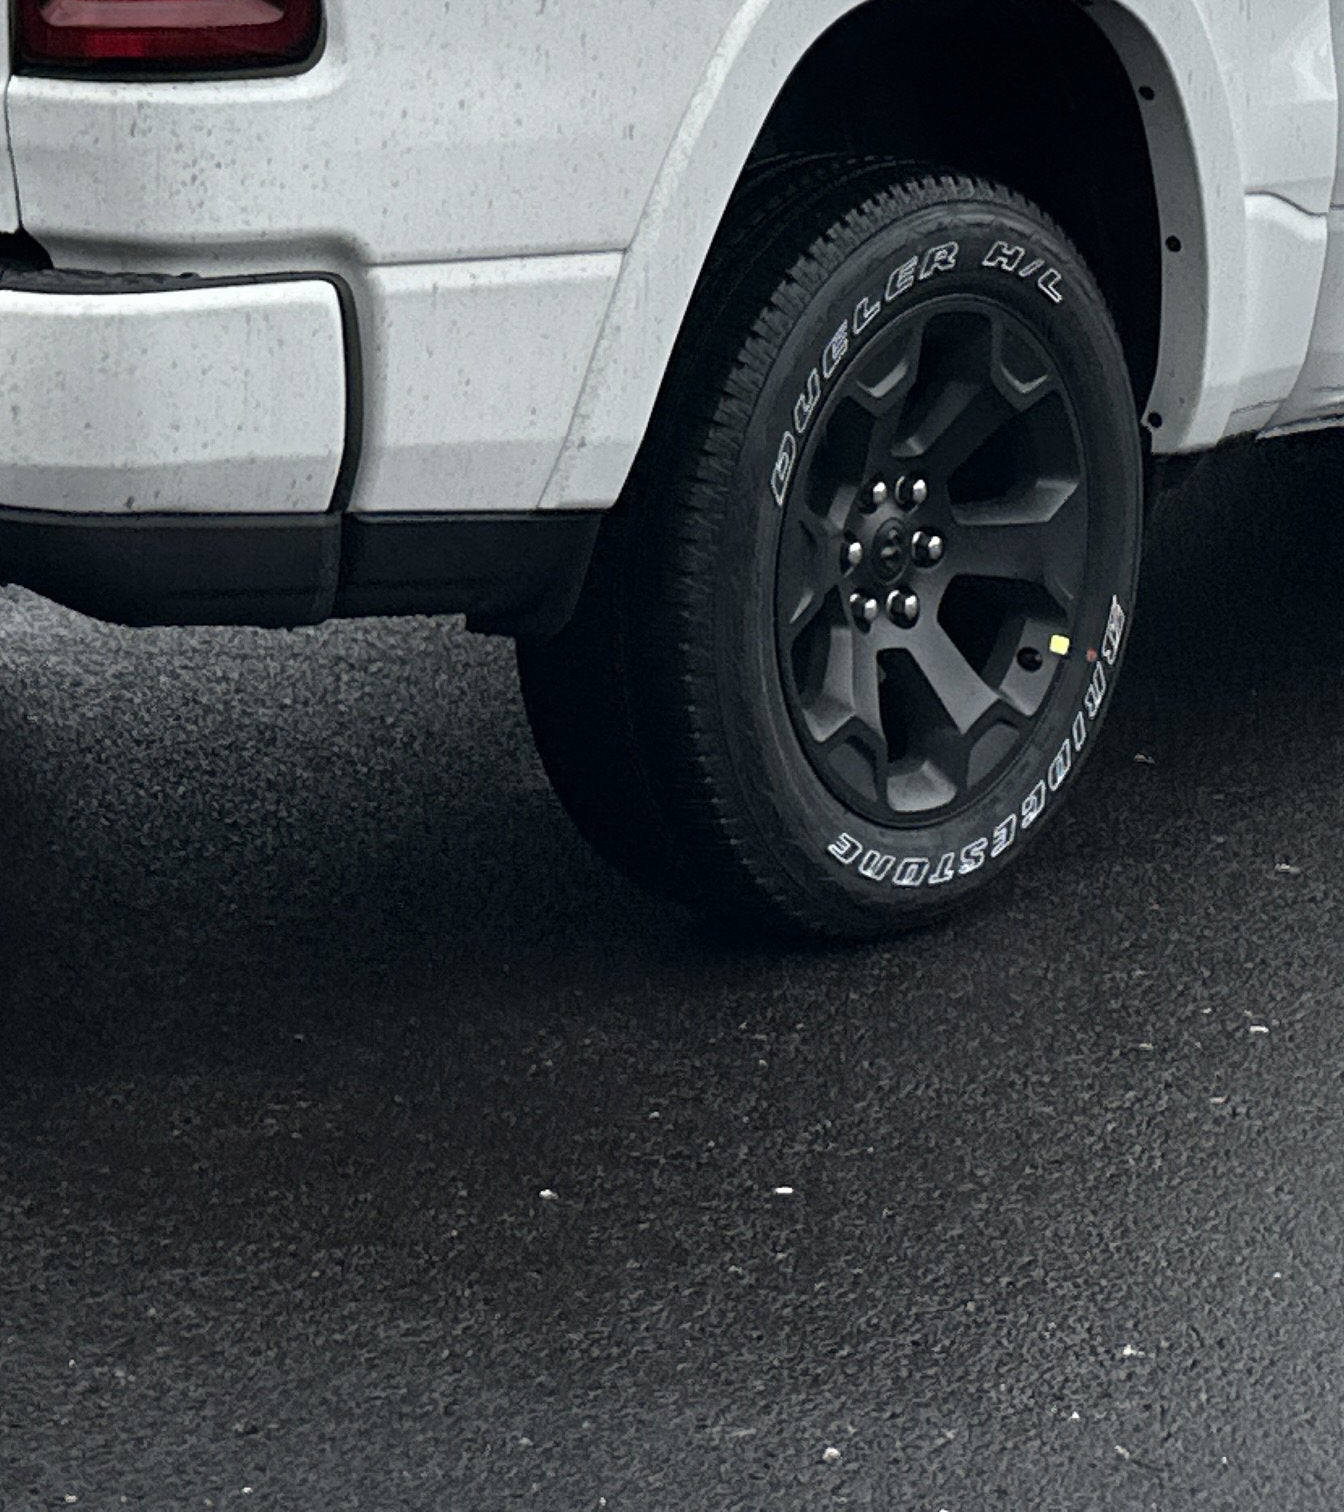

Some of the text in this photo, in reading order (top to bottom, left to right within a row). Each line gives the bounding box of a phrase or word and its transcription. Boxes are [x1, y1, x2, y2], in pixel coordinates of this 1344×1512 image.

[770, 240, 1064, 505] DUELER H/L
[828, 593, 1126, 888] BRIDGESTONE
